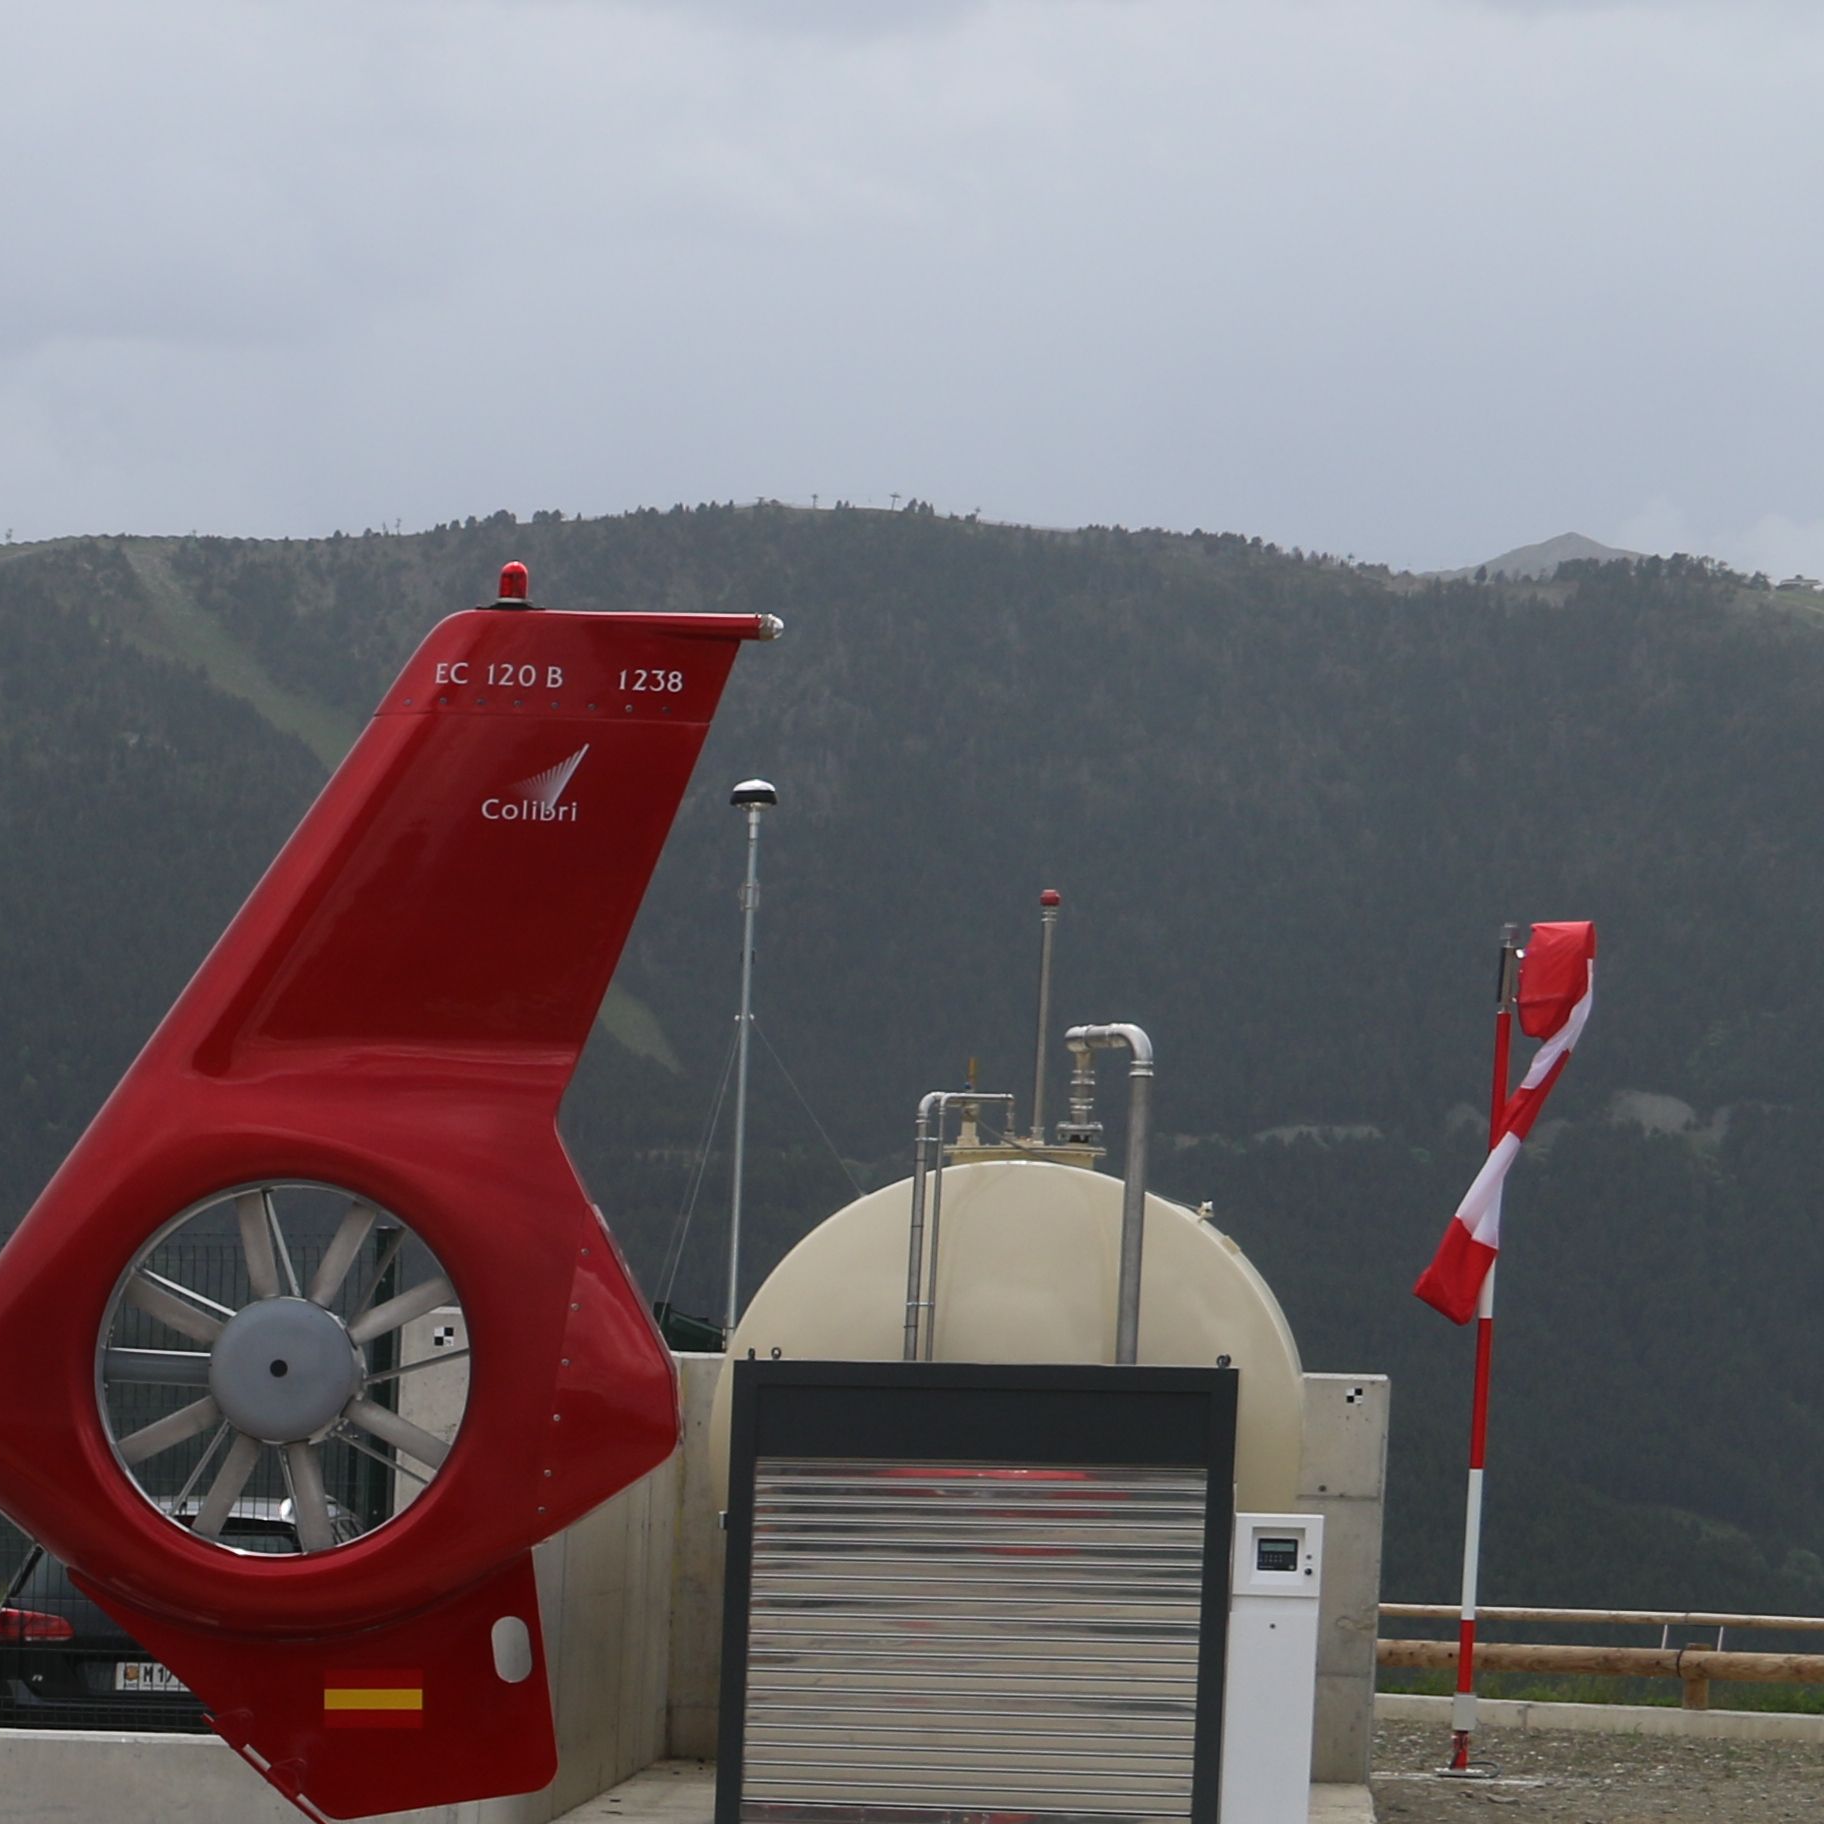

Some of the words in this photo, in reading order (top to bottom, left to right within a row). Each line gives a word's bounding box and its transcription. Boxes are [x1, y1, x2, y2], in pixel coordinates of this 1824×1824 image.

[435, 662, 469, 686] EC
[486, 663, 536, 688] 120
[546, 666, 564, 688] B
[618, 669, 684, 693] 1238
[481, 798, 578, 822] Colibri
